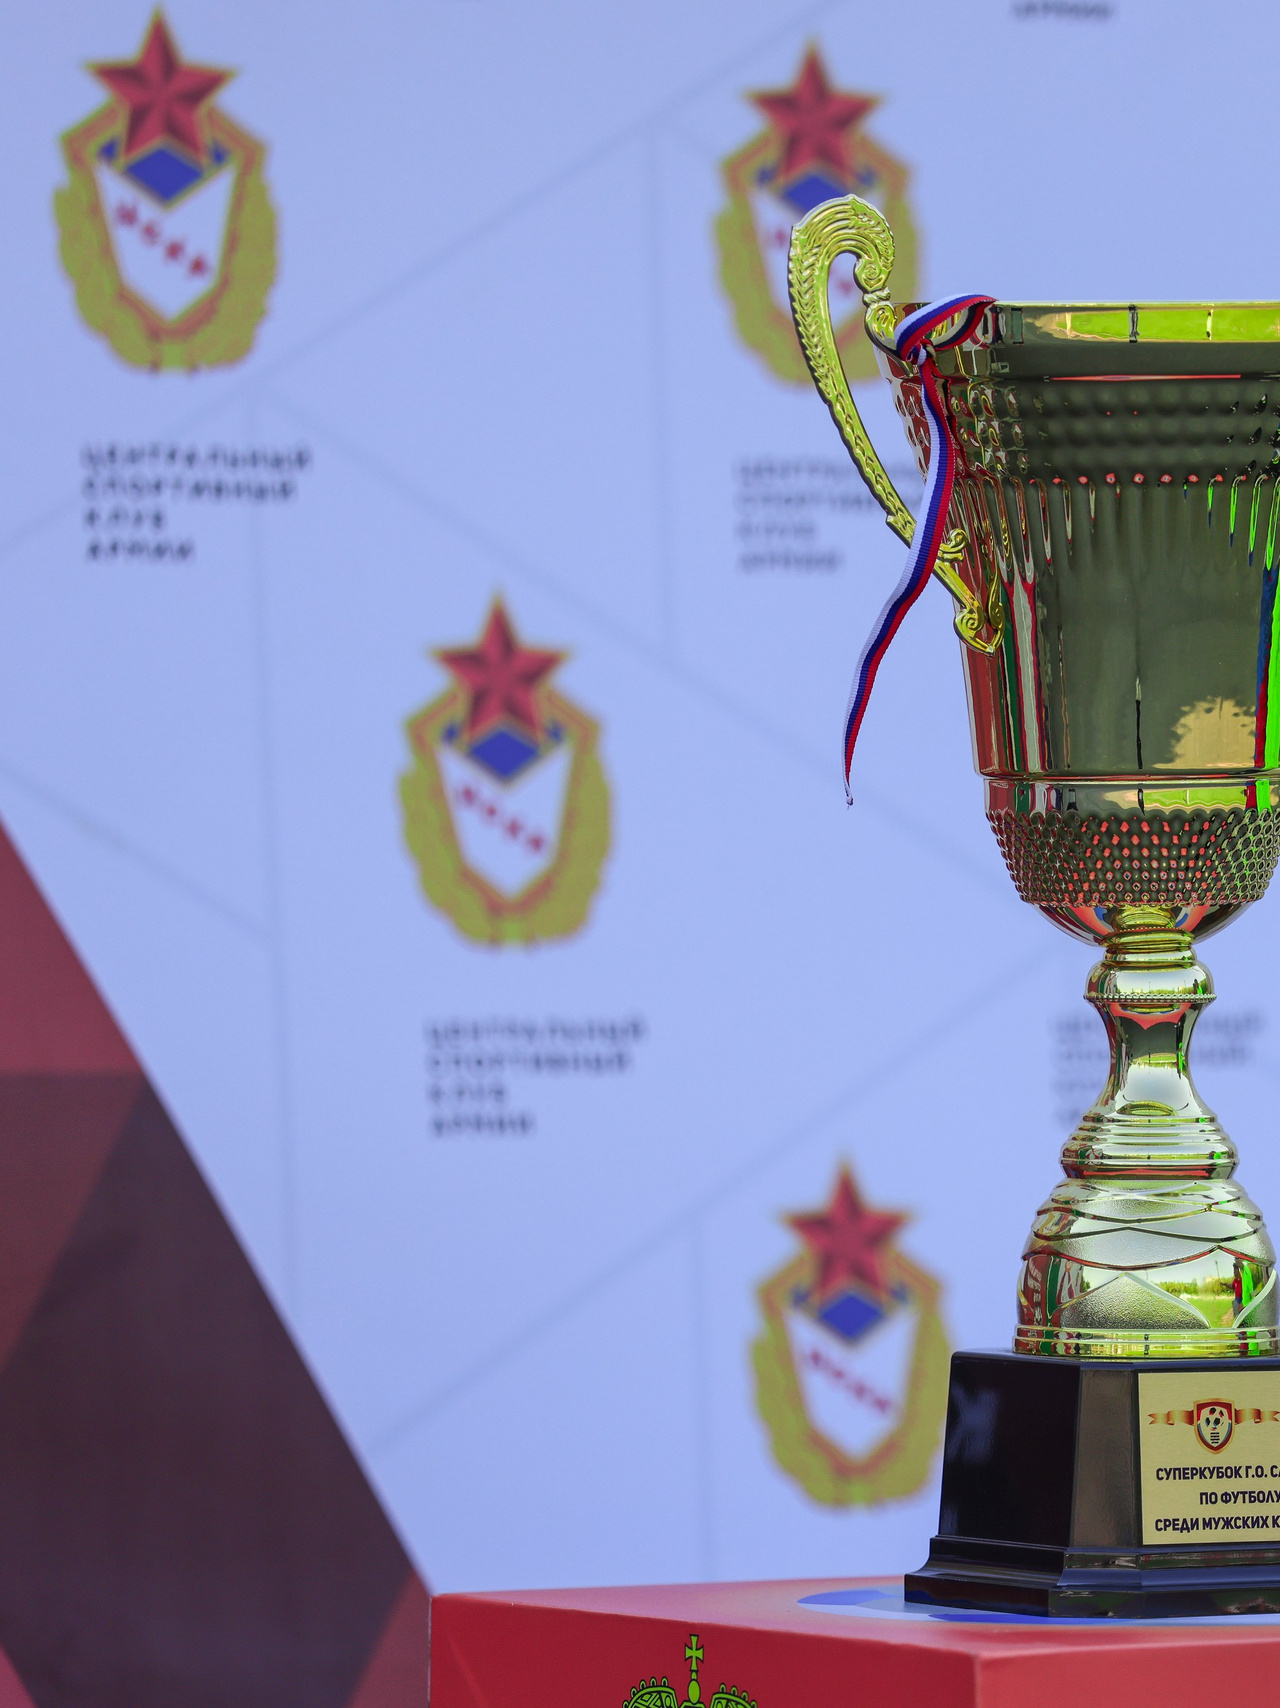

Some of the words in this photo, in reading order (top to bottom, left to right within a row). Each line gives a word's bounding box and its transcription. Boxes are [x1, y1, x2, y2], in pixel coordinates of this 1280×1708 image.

[1156, 1465, 1243, 1481] СУПЕРКУБОК
[1245, 1465, 1268, 1479] Г.О.
[1199, 1491, 1218, 1505] ПО
[1155, 1517, 1200, 1534] СРЕДИ
[1202, 1515, 1270, 1531] МУЖСКИХ
